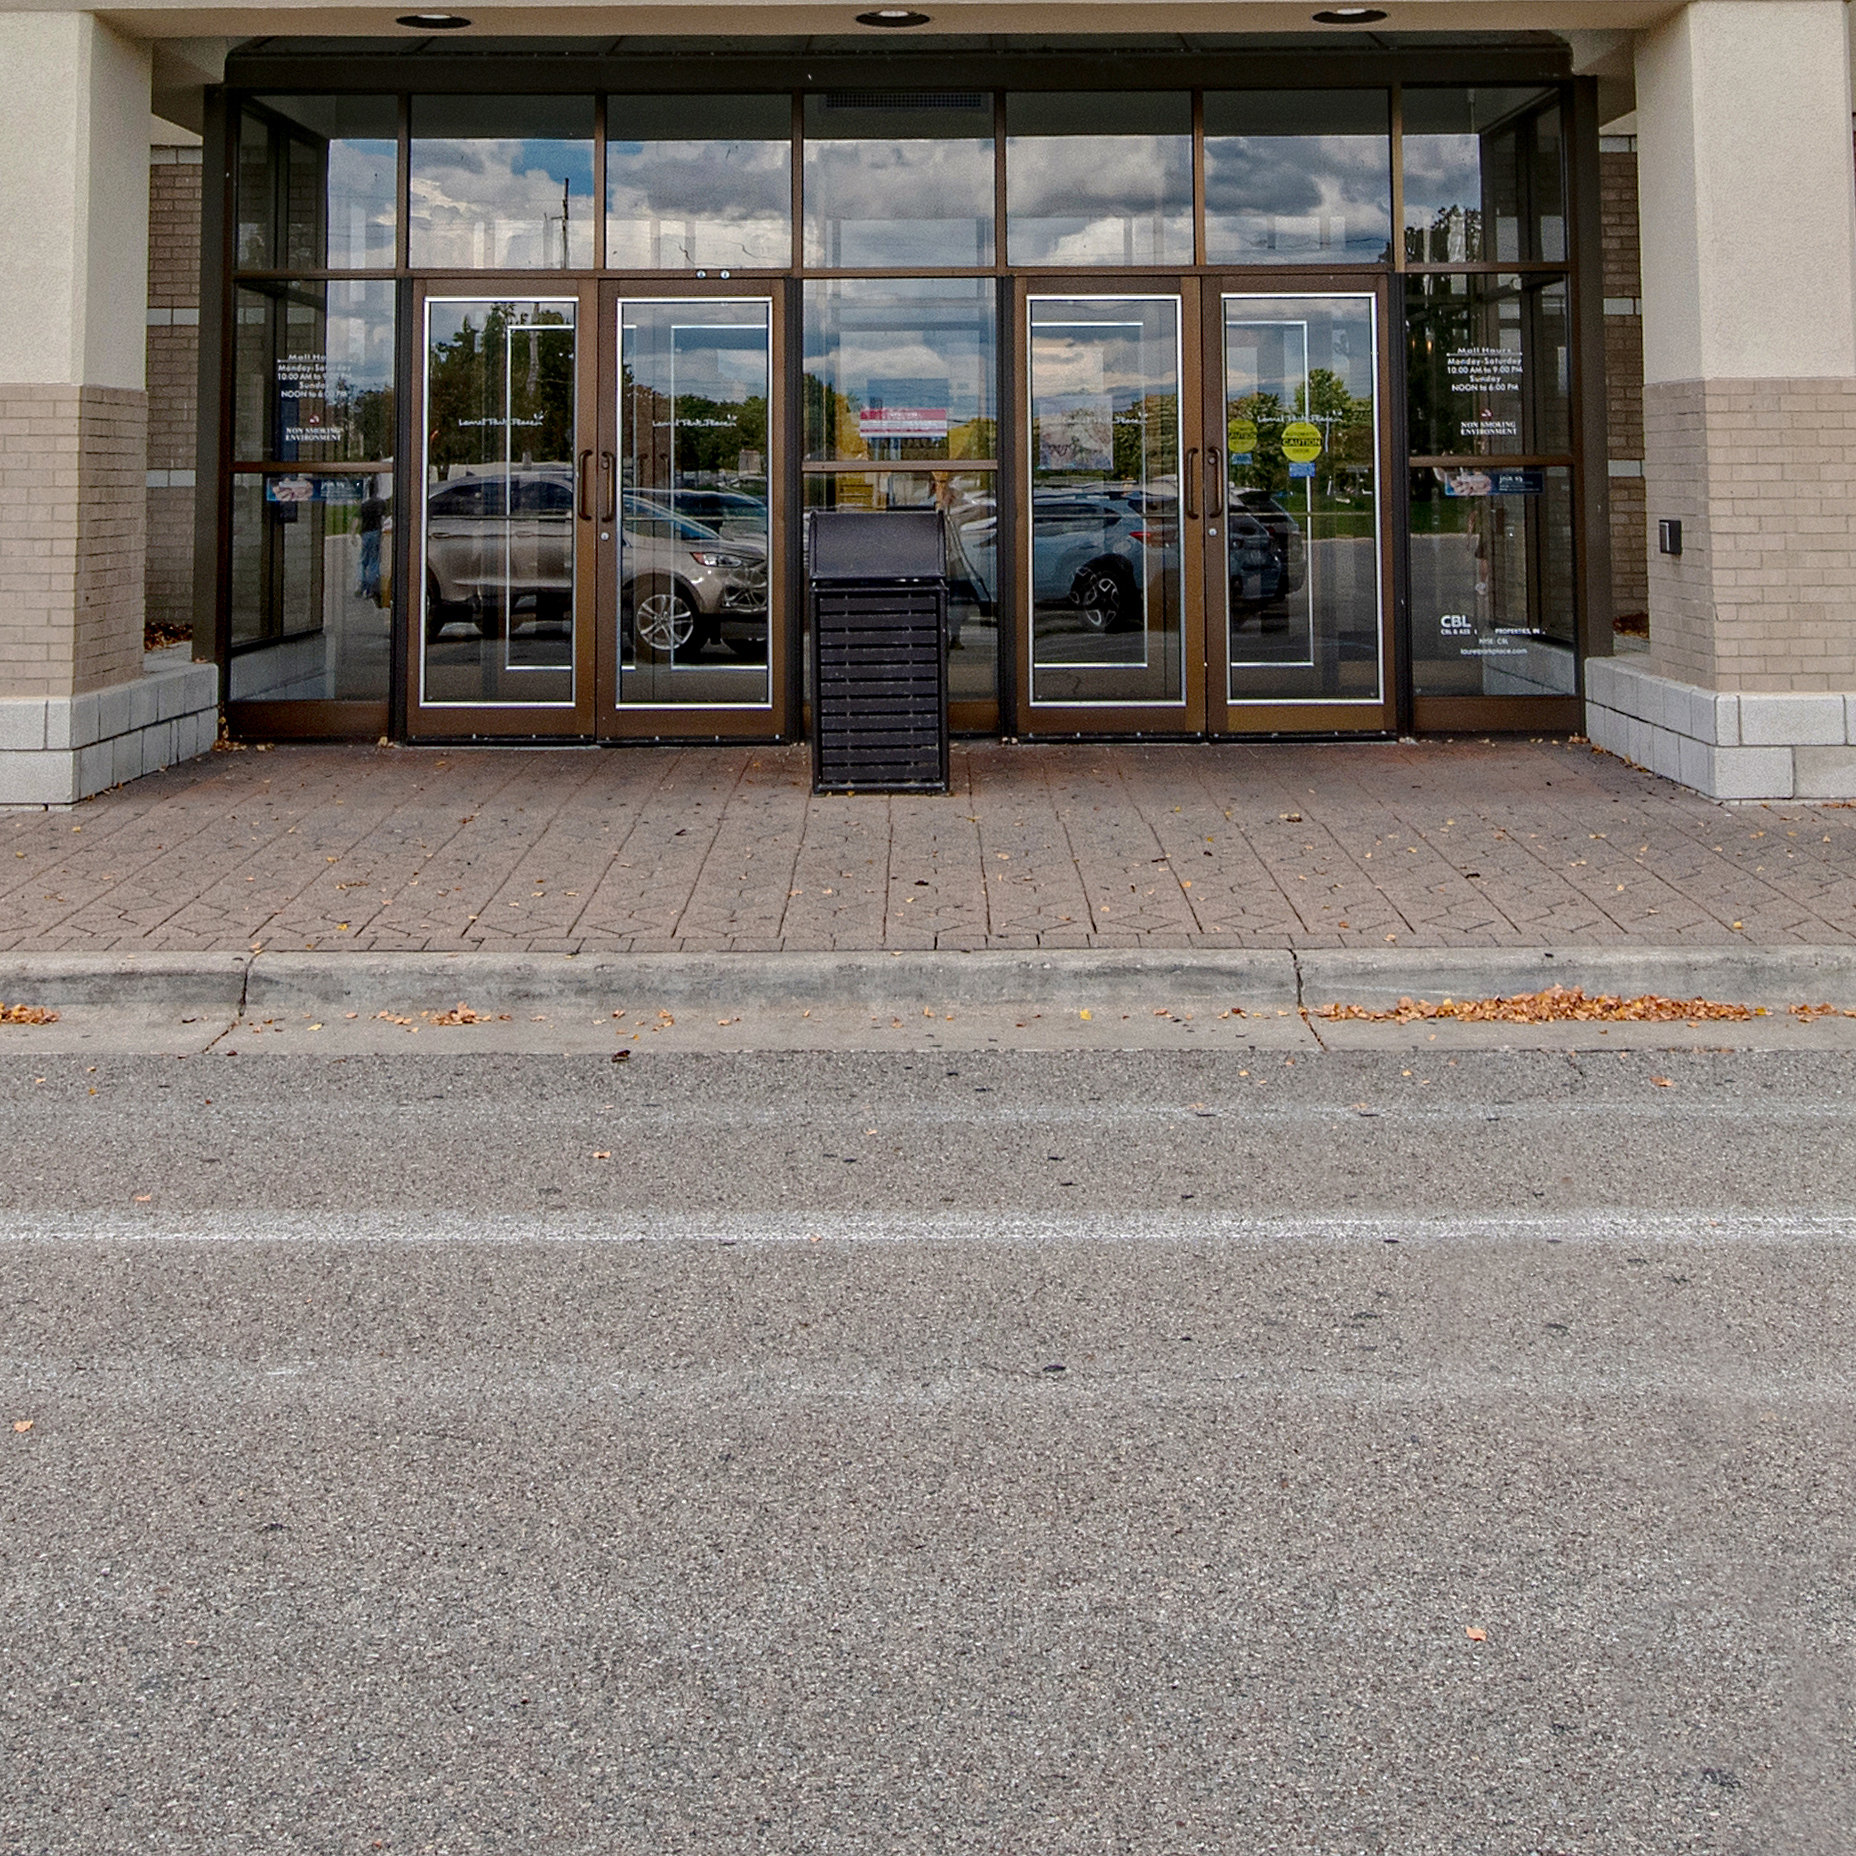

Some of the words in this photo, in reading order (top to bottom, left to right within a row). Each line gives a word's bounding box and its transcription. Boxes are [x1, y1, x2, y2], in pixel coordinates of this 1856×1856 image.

[1470, 366, 1483, 374] AM
[1484, 366, 1492, 374] to
[1469, 375, 1501, 383] Sunday
[1451, 384, 1478, 392] NOON
[280, 390, 307, 399] NOON
[285, 434, 341, 442] ENVIRONMENT
[1283, 438, 1321, 447] CAUTION
[1440, 615, 1472, 628] CBL
